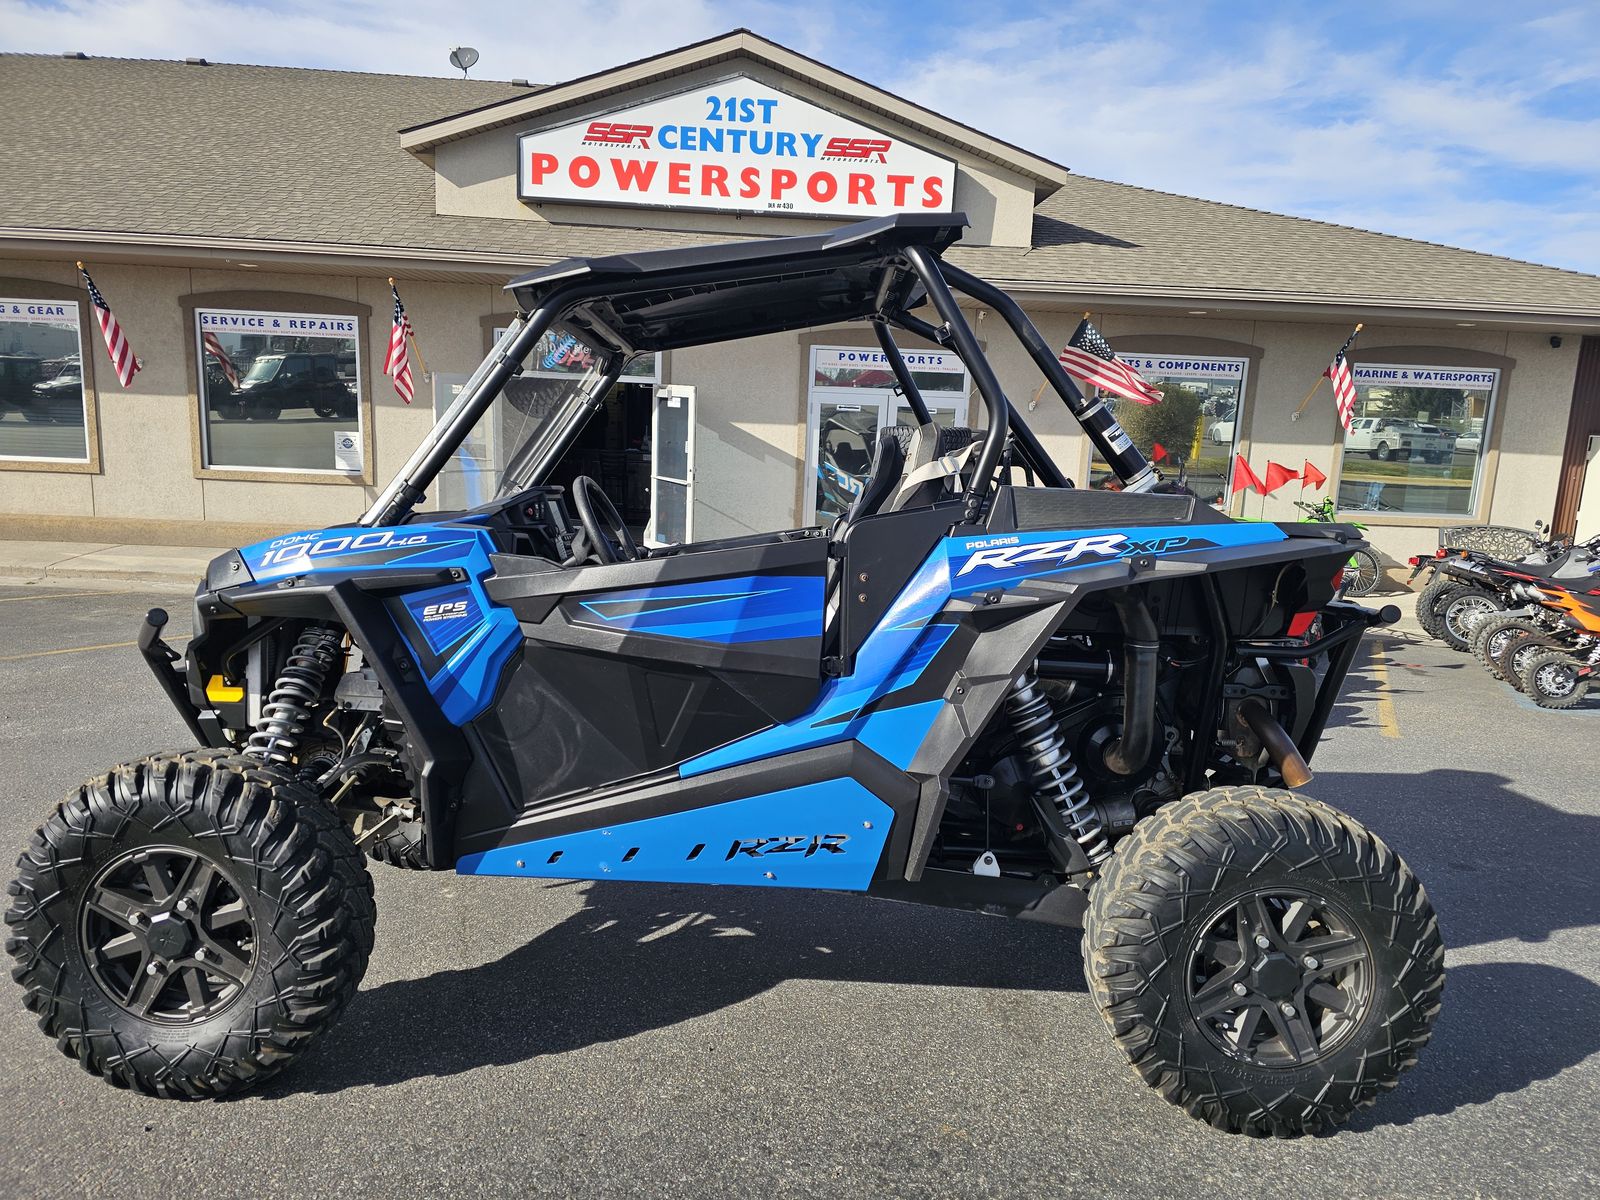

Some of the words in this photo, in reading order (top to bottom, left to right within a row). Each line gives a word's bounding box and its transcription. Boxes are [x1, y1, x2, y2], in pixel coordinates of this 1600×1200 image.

[706, 96, 778, 124] 21ST
[583, 122, 654, 149] SSR
[657, 124, 824, 158] CENTURY
[581, 141, 641, 149] MOTORSPORTS
[823, 137, 892, 164] SSR
[820, 156, 879, 164] MOTORSPORTS
[531, 152, 944, 208] POWERSPORTS
[12, 305, 21, 314] &
[28, 306, 65, 315] GEAR
[202, 315, 264, 327] SERVICE
[272, 319, 281, 328] &
[289, 319, 353, 331] REPAIRS
[838, 352, 943, 364] POWERORTS
[1145, 360, 1153, 368] &
[1158, 360, 1240, 372] COMPONENTS
[1354, 369, 1398, 378] MARINE
[1401, 371, 1409, 379] &
[1413, 371, 1493, 382] WATERSPORTS
[269, 532, 323, 549] DOHC
[965, 536, 1020, 551] POLARIS
[260, 531, 394, 567] 1000
[955, 534, 1129, 577] RZR
[1116, 536, 1190, 558] XP
[423, 600, 468, 615] EPS
[725, 834, 851, 861] RZR
